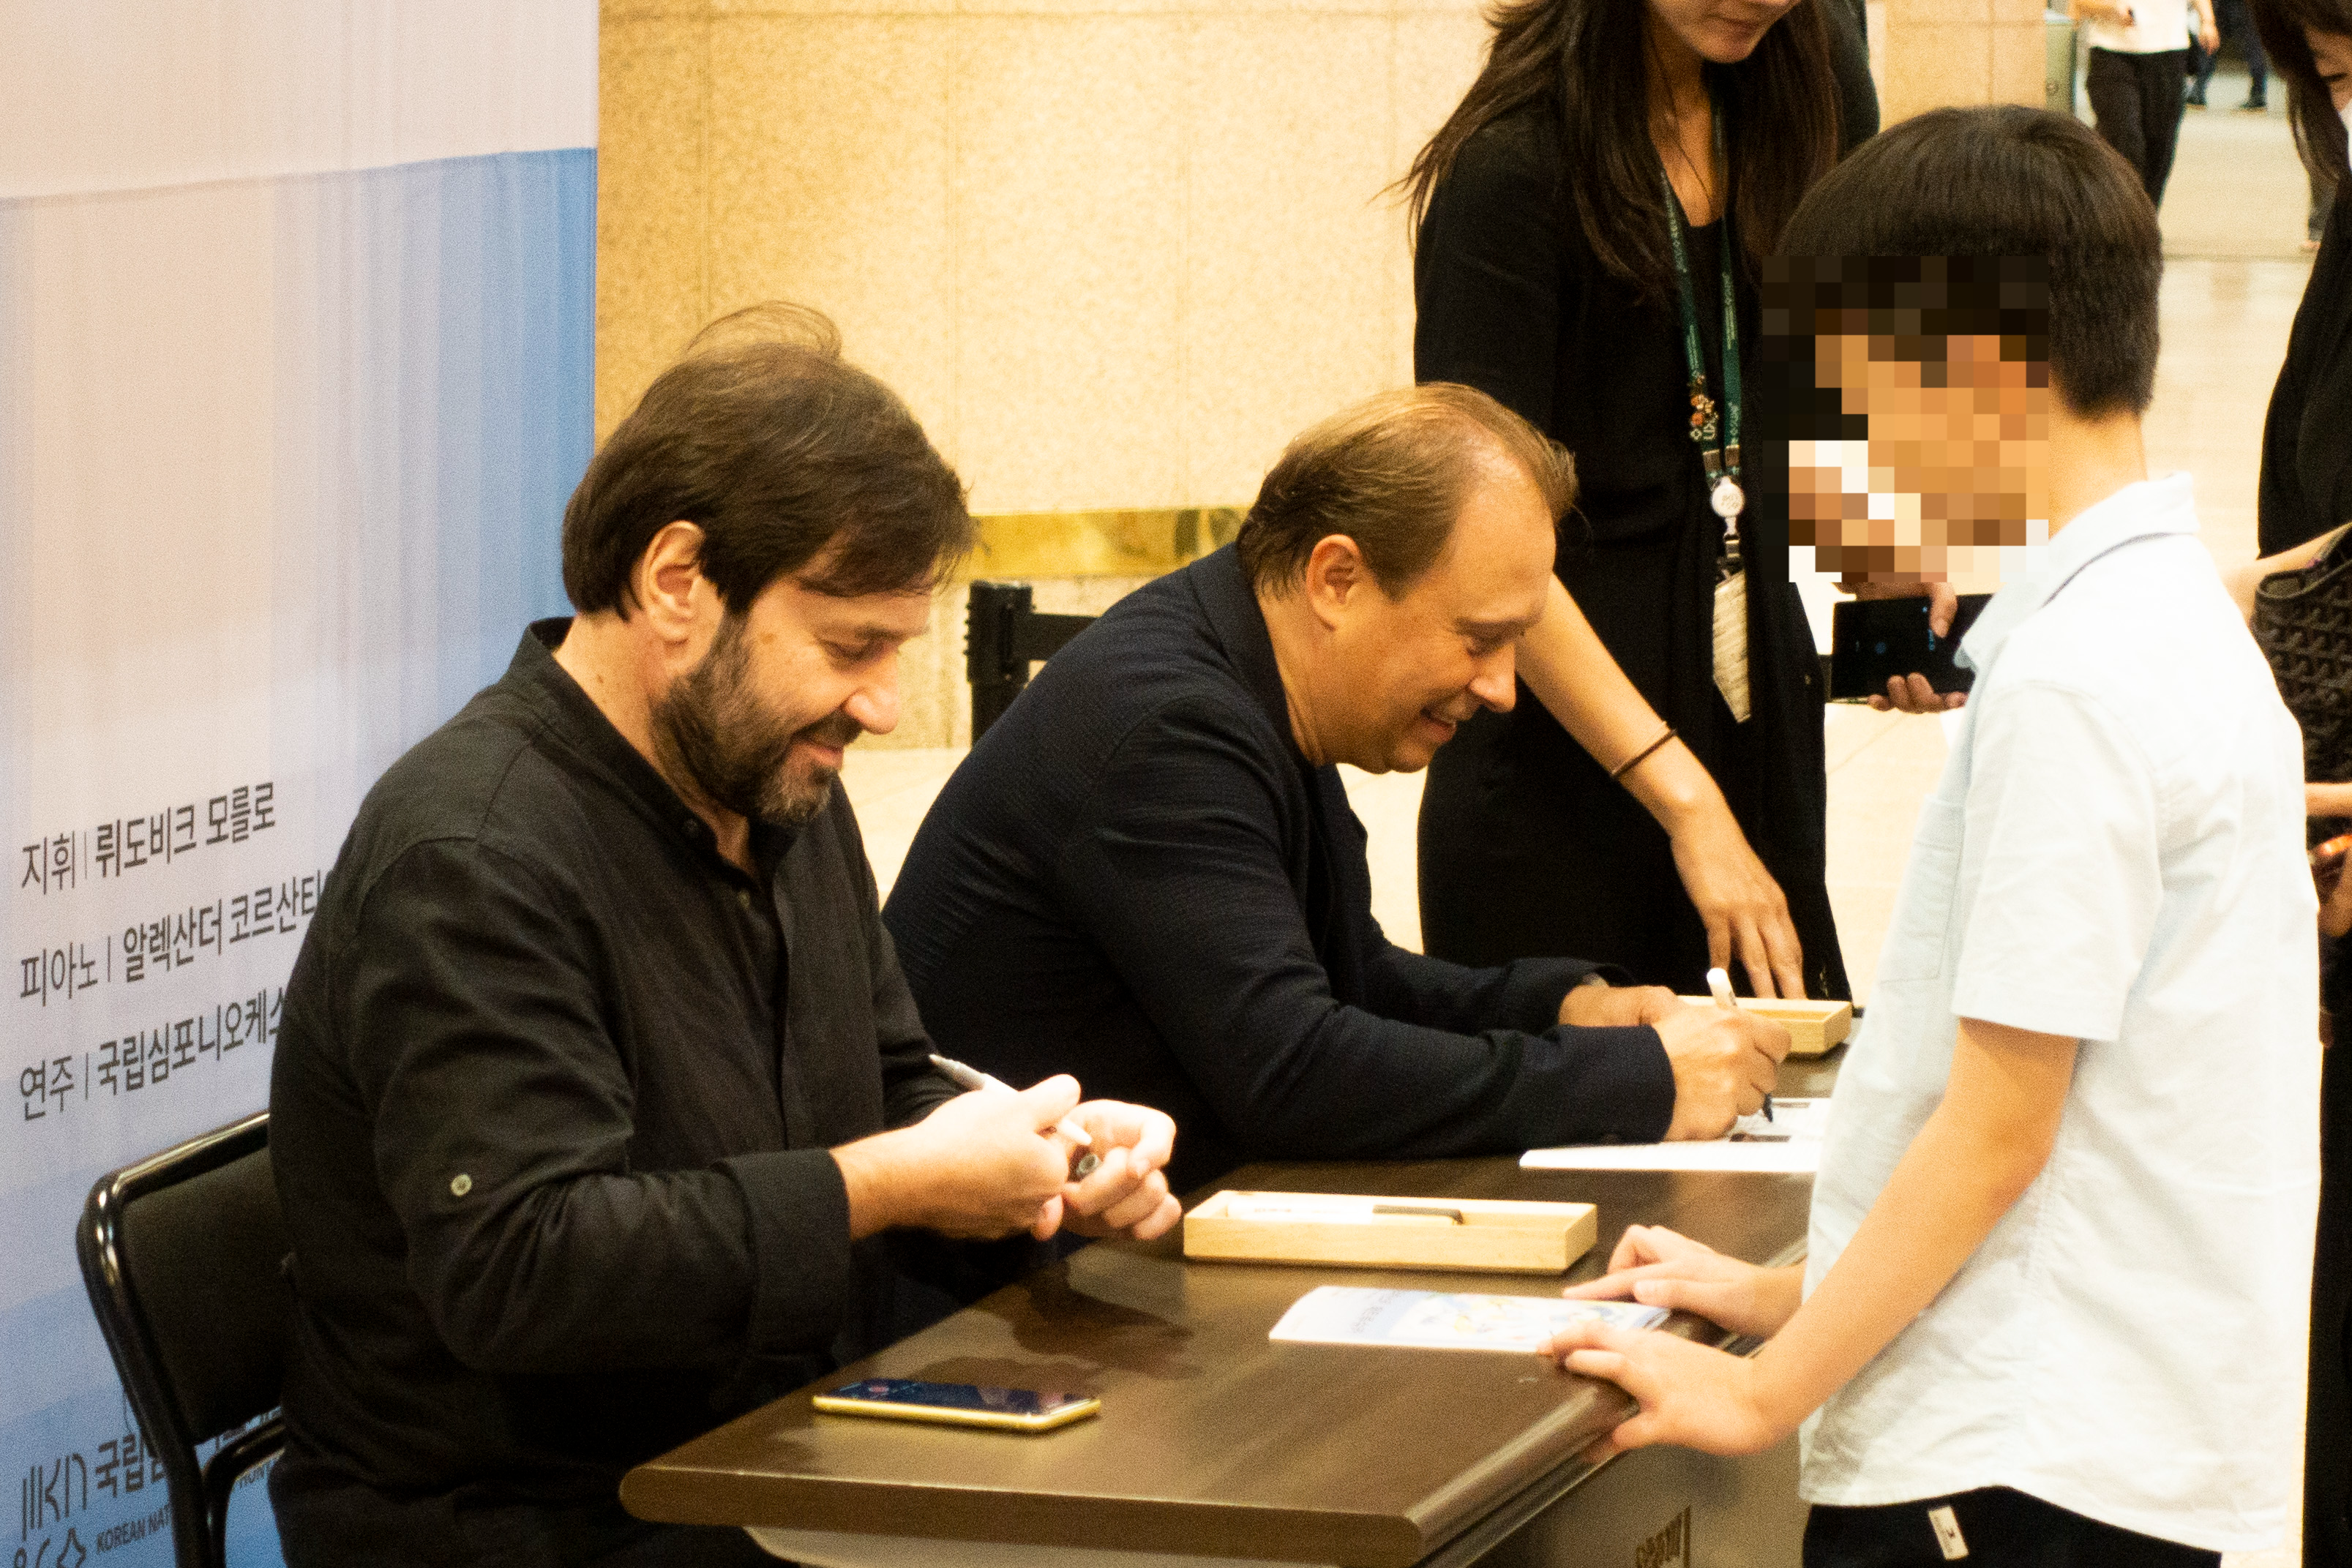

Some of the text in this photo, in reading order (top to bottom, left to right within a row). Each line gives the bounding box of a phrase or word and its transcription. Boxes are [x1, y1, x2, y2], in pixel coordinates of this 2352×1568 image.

[21, 781, 276, 896] 지휘 뤼도비크 모를로
[20, 942, 98, 1007] 피아노
[123, 899, 222, 983] 알렉산더
[20, 1054, 75, 1121] 연주
[96, 1518, 146, 1556] KOREAN
